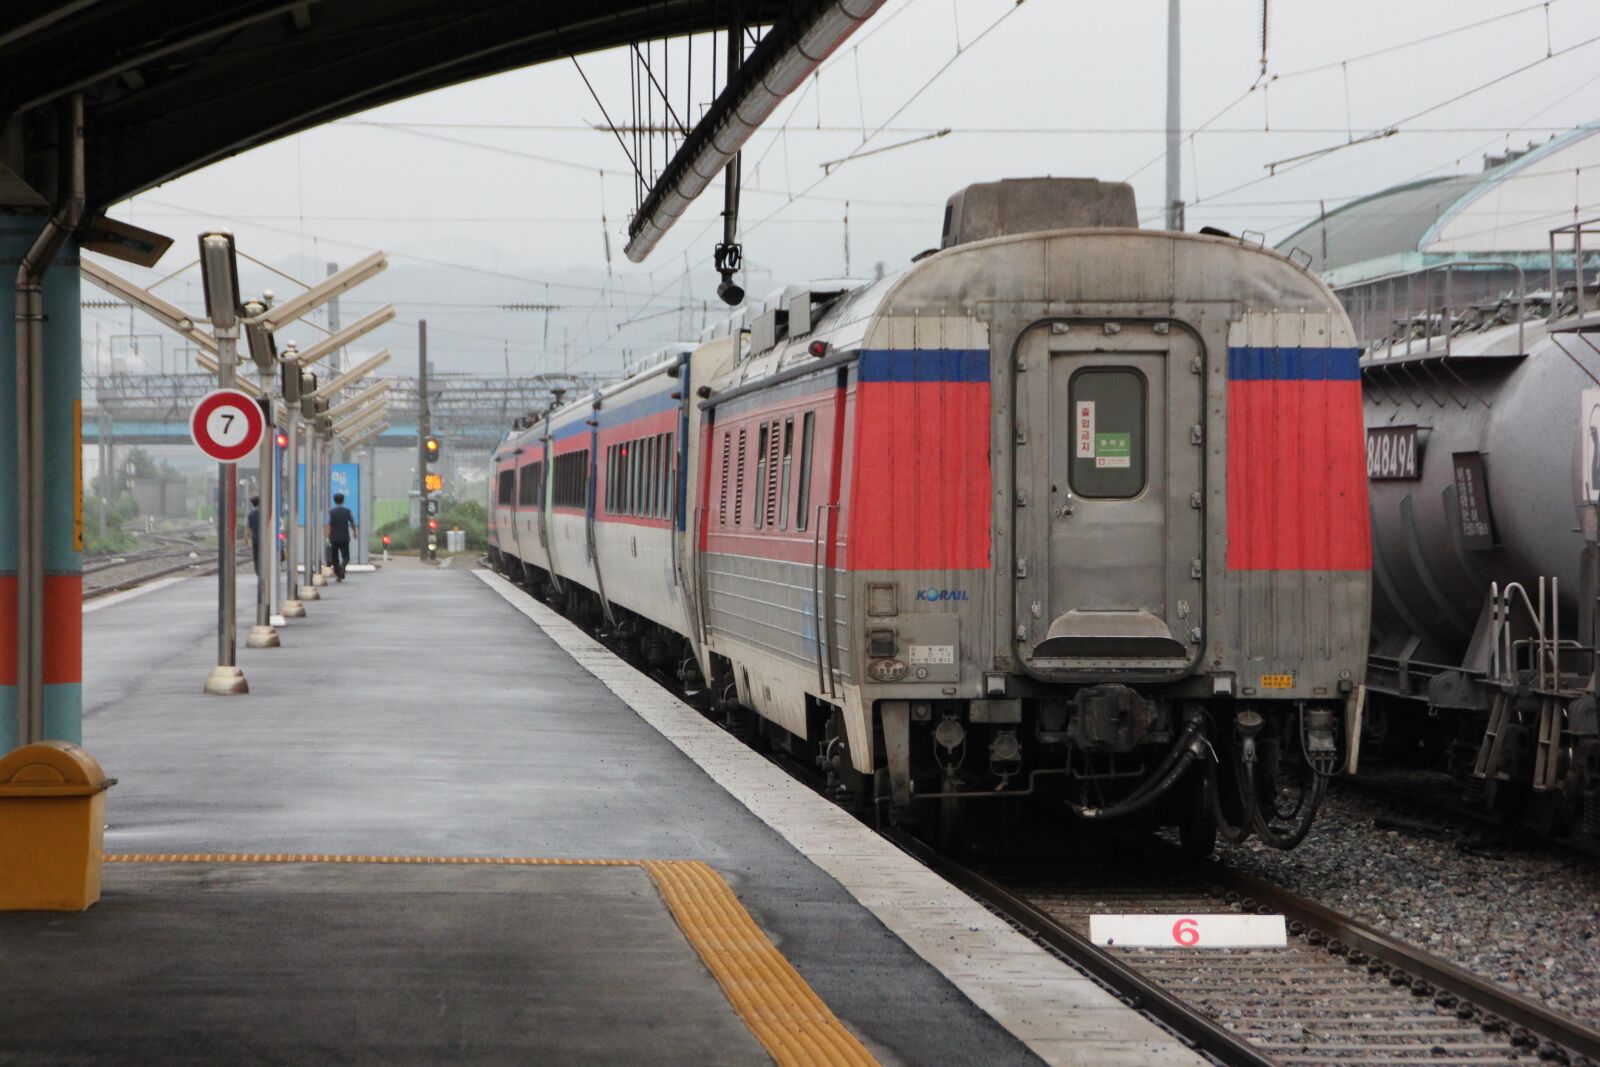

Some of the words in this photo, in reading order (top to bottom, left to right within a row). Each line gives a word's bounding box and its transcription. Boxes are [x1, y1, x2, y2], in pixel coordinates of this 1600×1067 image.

[221, 414, 234, 434] 7
[1081, 408, 1090, 451] 출입금지
[1367, 433, 1415, 477] 848494
[916, 587, 969, 602] KORAIL
[1172, 918, 1200, 946] 6
